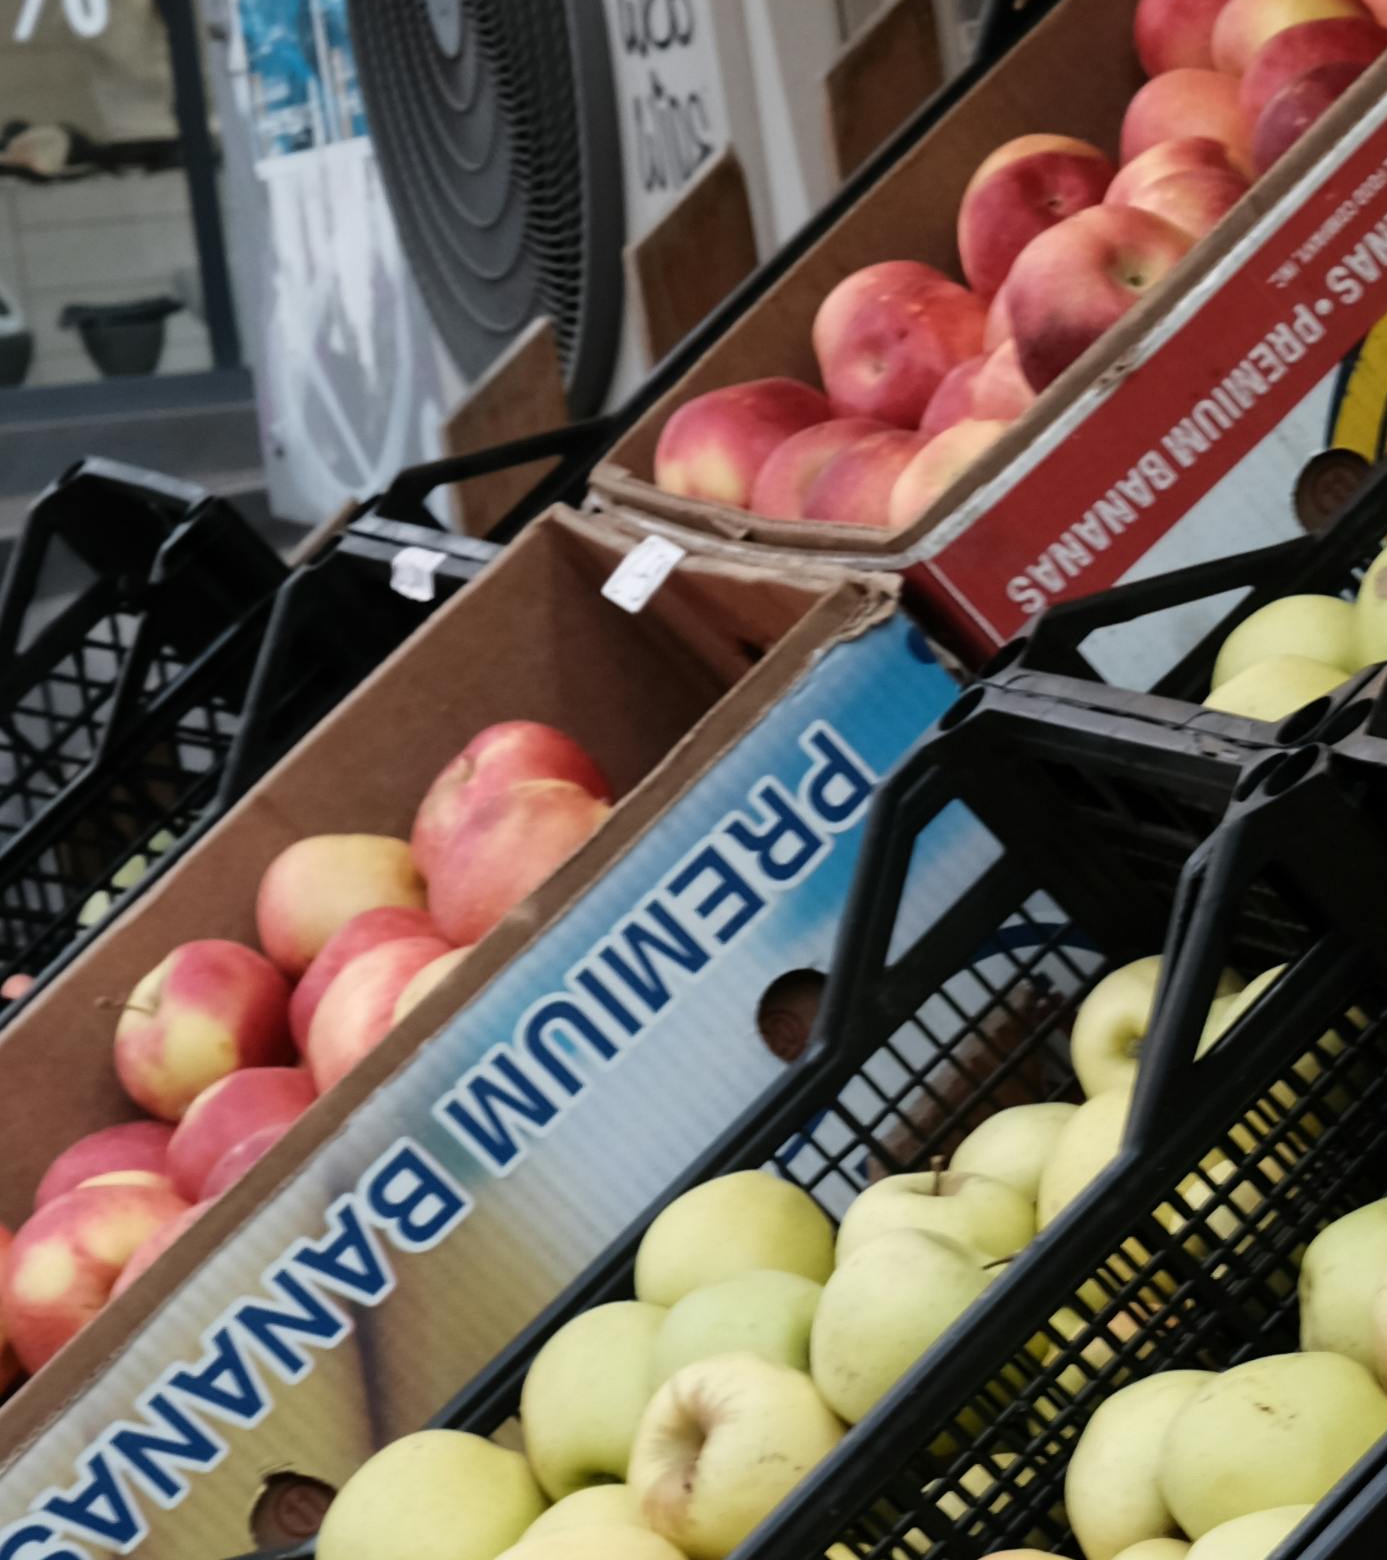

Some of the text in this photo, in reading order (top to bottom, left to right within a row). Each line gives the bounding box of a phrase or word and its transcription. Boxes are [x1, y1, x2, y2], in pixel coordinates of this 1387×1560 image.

[1161, 302, 1327, 469] PREMIUM
[1006, 449, 1179, 615] BANANAS
[438, 725, 878, 1173] PREMIUM
